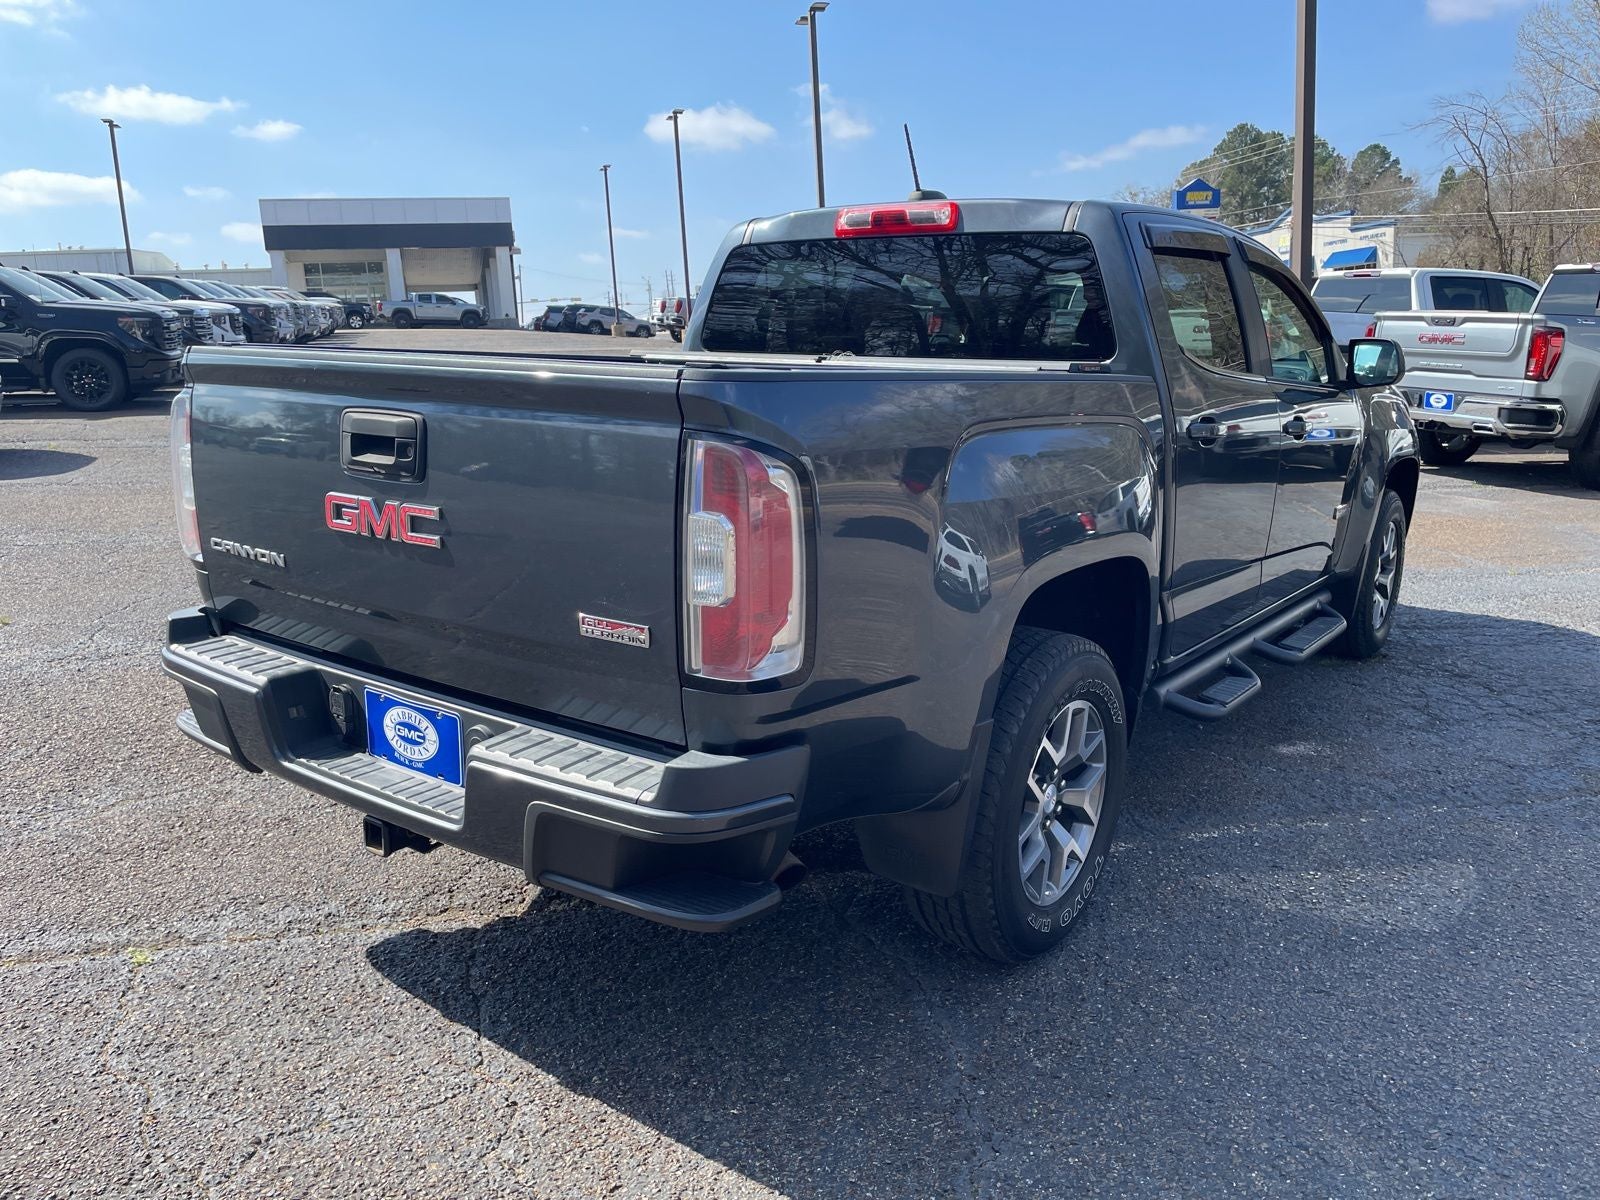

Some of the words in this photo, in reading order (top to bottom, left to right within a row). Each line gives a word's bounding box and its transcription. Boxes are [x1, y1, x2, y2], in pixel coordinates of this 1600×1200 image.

[1419, 333, 1466, 345] GMC
[324, 491, 442, 550] GMC
[210, 537, 287, 568] CANYON
[585, 618, 612, 630] ALL
[583, 627, 645, 645] TERRAIN
[1071, 679, 1123, 724] COUNTRY
[388, 710, 429, 733] GABRIEL
[395, 724, 424, 743] GMC
[391, 735, 430, 759] JORDAN
[1060, 856, 1104, 927] TOYO
[1027, 912, 1051, 933] H/T
